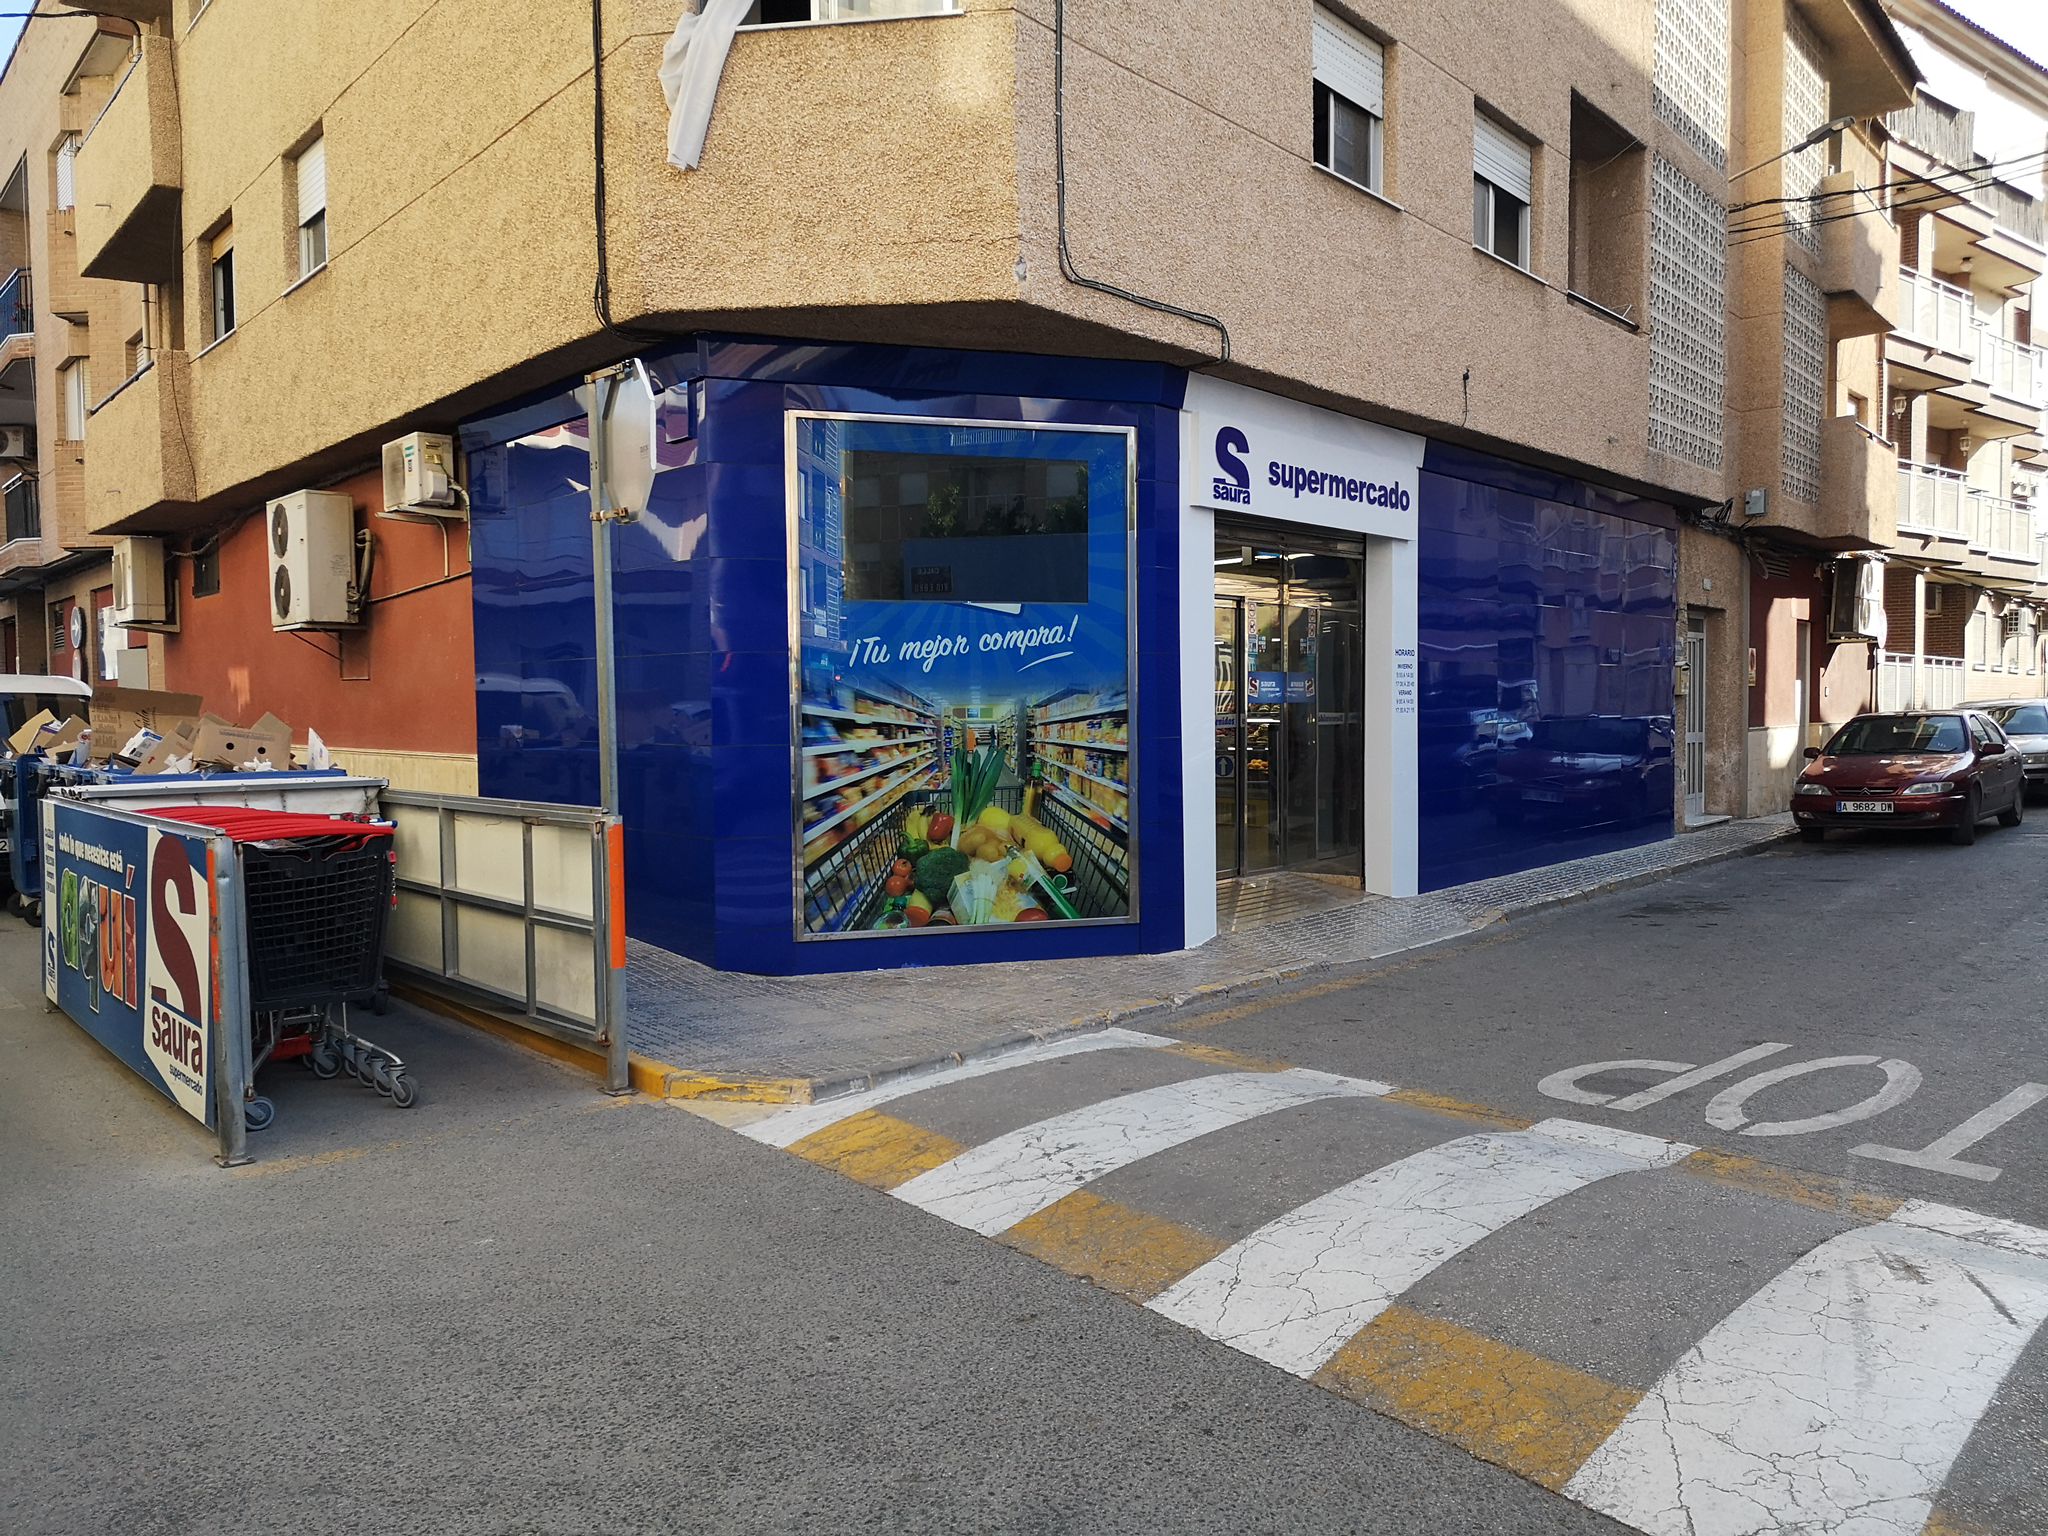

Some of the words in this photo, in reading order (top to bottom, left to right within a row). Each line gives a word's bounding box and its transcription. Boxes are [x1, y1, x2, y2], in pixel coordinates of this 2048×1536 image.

[1213, 483, 1251, 505] saura
[1268, 461, 1411, 512] supermercado
[848, 635, 891, 668] ¡Tu
[899, 633, 970, 674] mejor
[979, 614, 1079, 656] compra!
[1842, 803, 1847, 811] A
[1852, 802, 1876, 811] 9682
[75, 840, 84, 860] que
[85, 844, 109, 868] necesitas
[110, 850, 123, 873] está
[61, 864, 137, 1014] aquí
[151, 1006, 203, 1077] saura
[169, 1063, 203, 1096] supermercado
